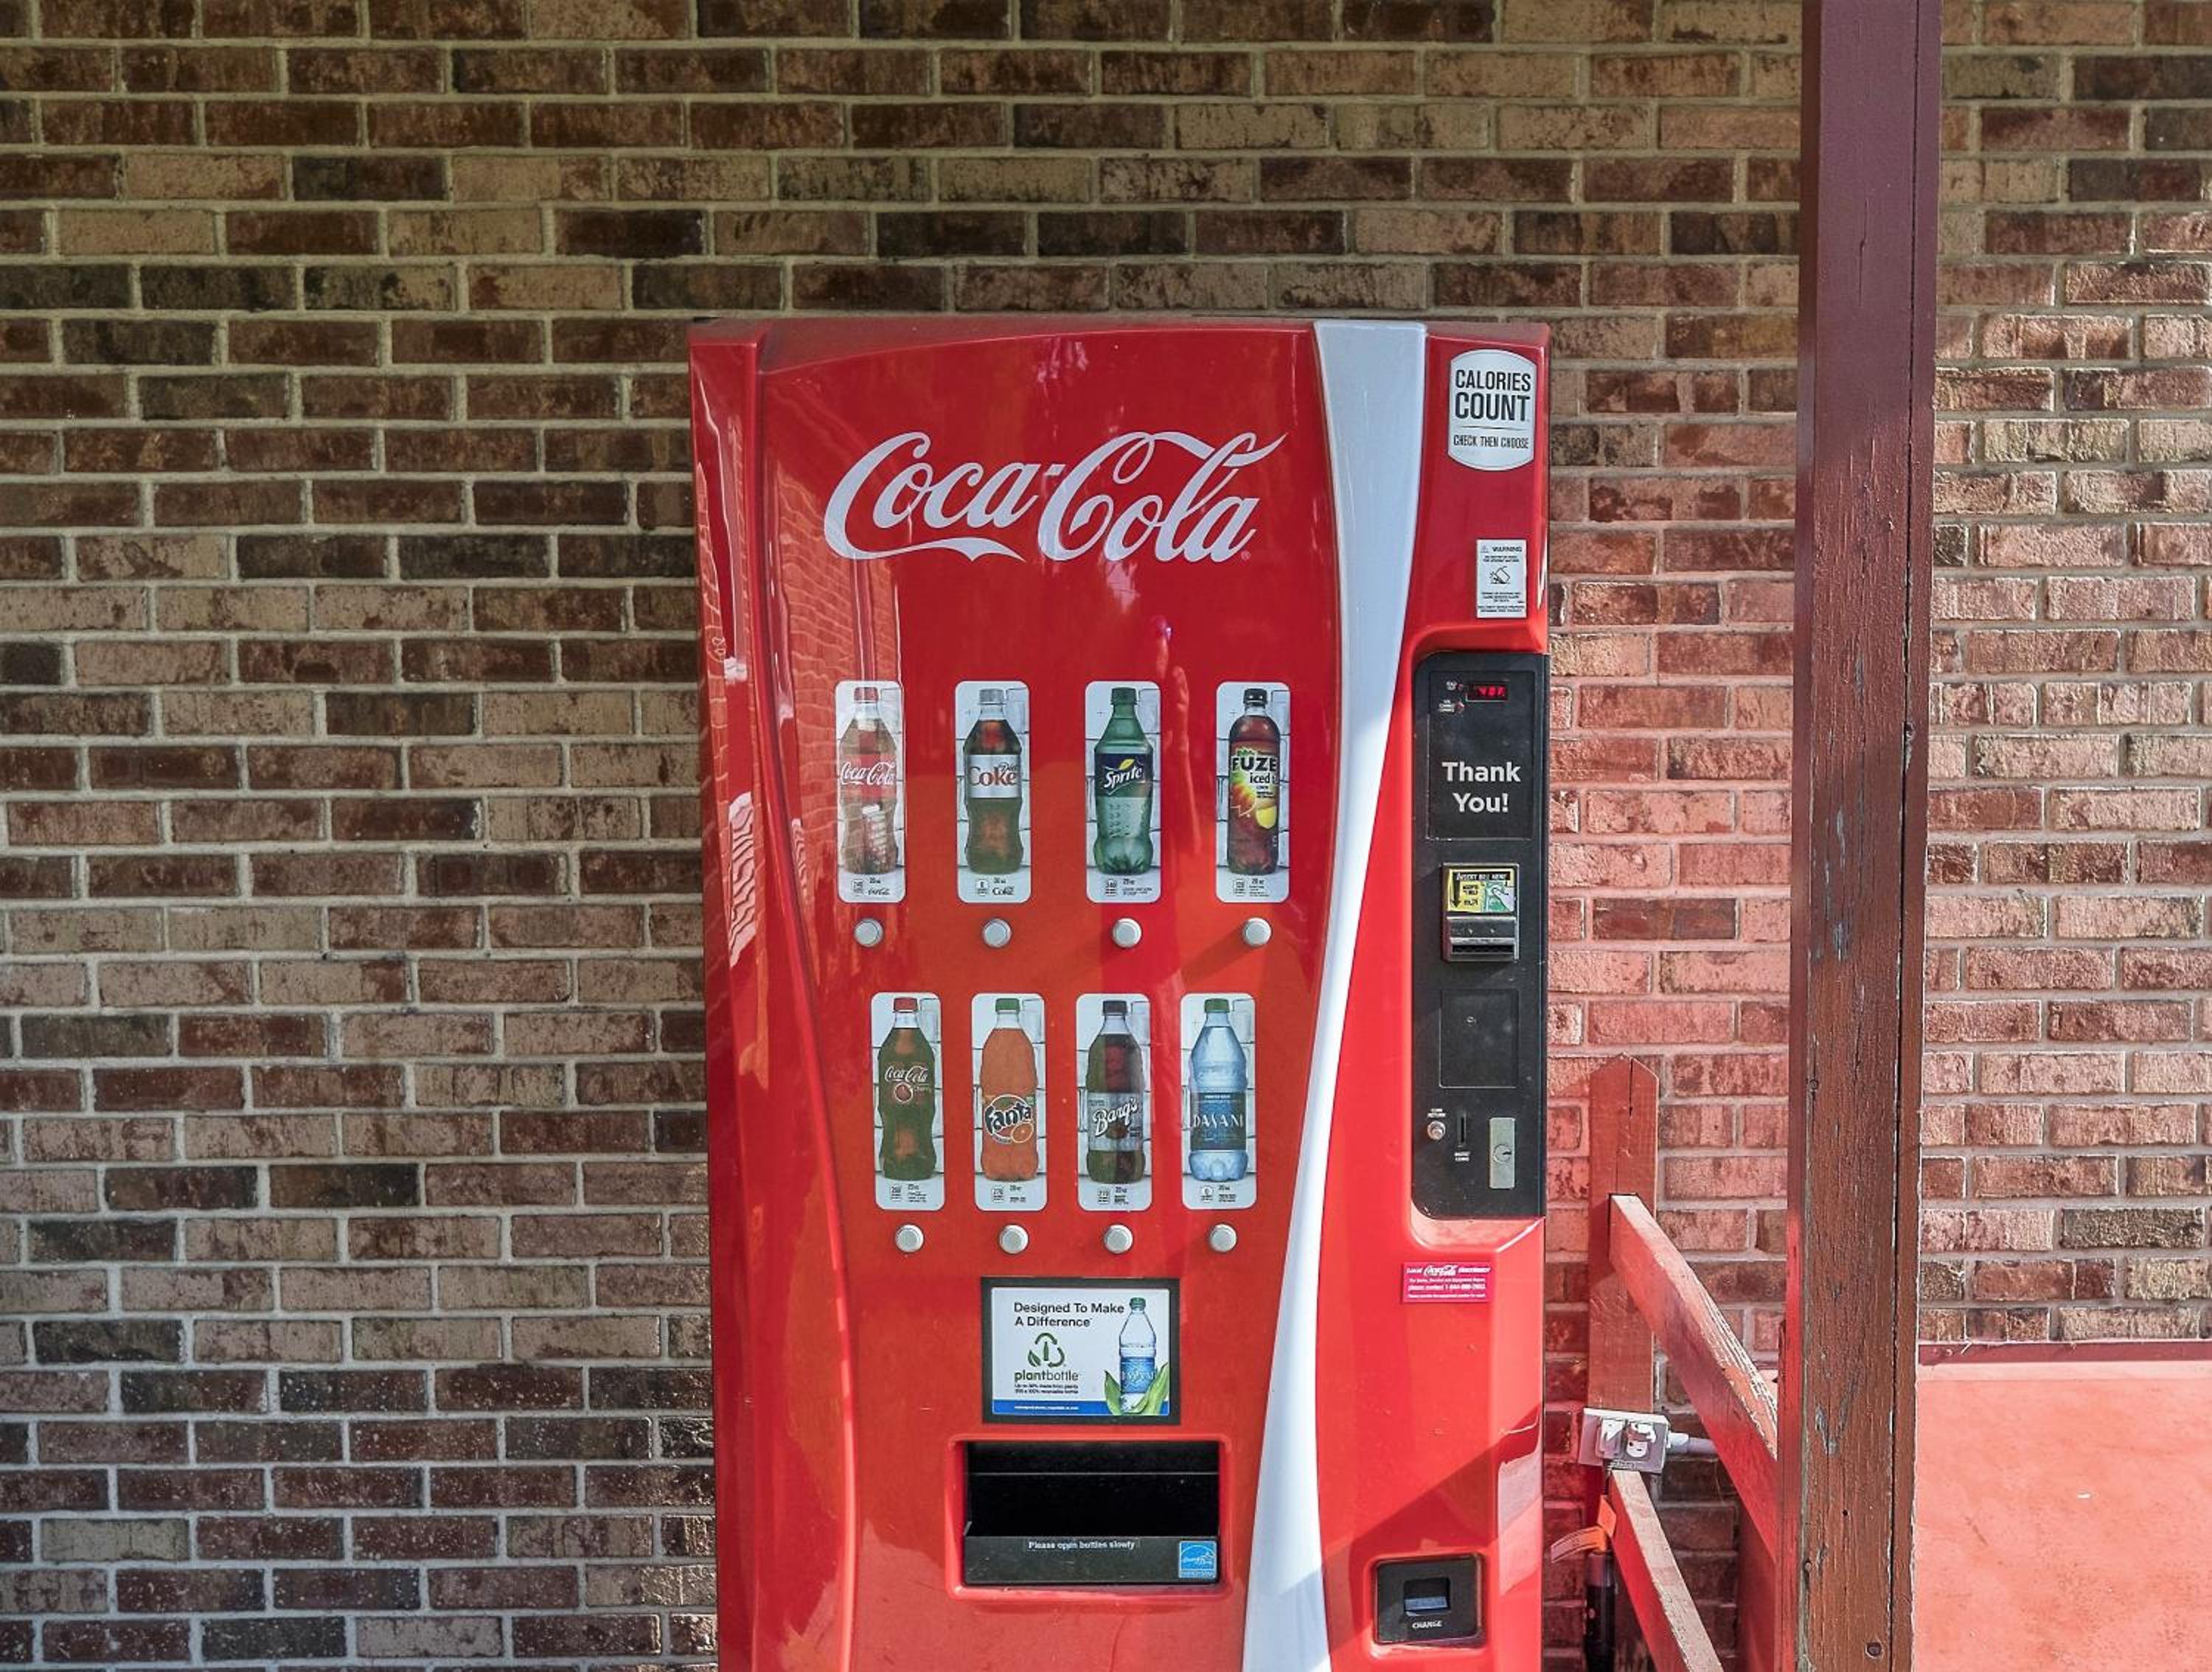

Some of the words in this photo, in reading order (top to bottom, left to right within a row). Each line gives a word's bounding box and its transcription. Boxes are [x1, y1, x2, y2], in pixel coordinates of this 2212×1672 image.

[1455, 369, 1531, 392] CALORIES
[1455, 391, 1531, 422] COUNT
[1453, 434, 1478, 447] CHECK
[1480, 436, 1499, 447] THEN
[1500, 436, 1529, 449] CHOOSE
[823, 431, 1287, 563] Coca-Cola
[840, 761, 896, 786] Coca-Cola
[1232, 757, 1278, 772] FUZE
[1441, 762, 1521, 782] Thank
[967, 765, 1018, 787] Coke
[1103, 765, 1144, 789] Sprite
[1250, 772, 1270, 784] iced
[1452, 793, 1509, 813] You!
[884, 1065, 929, 1084] Coca-Cola
[1092, 1097, 1138, 1138] Barq's
[1192, 1112, 1244, 1129] DASANI
[1014, 1302, 1071, 1315] Designed
[1074, 1303, 1088, 1313] To
[1091, 1303, 1125, 1314] Make
[1015, 1316, 1024, 1326] A
[1027, 1315, 1091, 1327] Difference
[1015, 1369, 1079, 1383] plantbottle
[1028, 1541, 1055, 1549] Please
[1057, 1542, 1078, 1550] open
[1079, 1541, 1107, 1549] bottles
[1108, 1540, 1135, 1550] slowly
[1412, 1620, 1443, 1629] CHANGE
